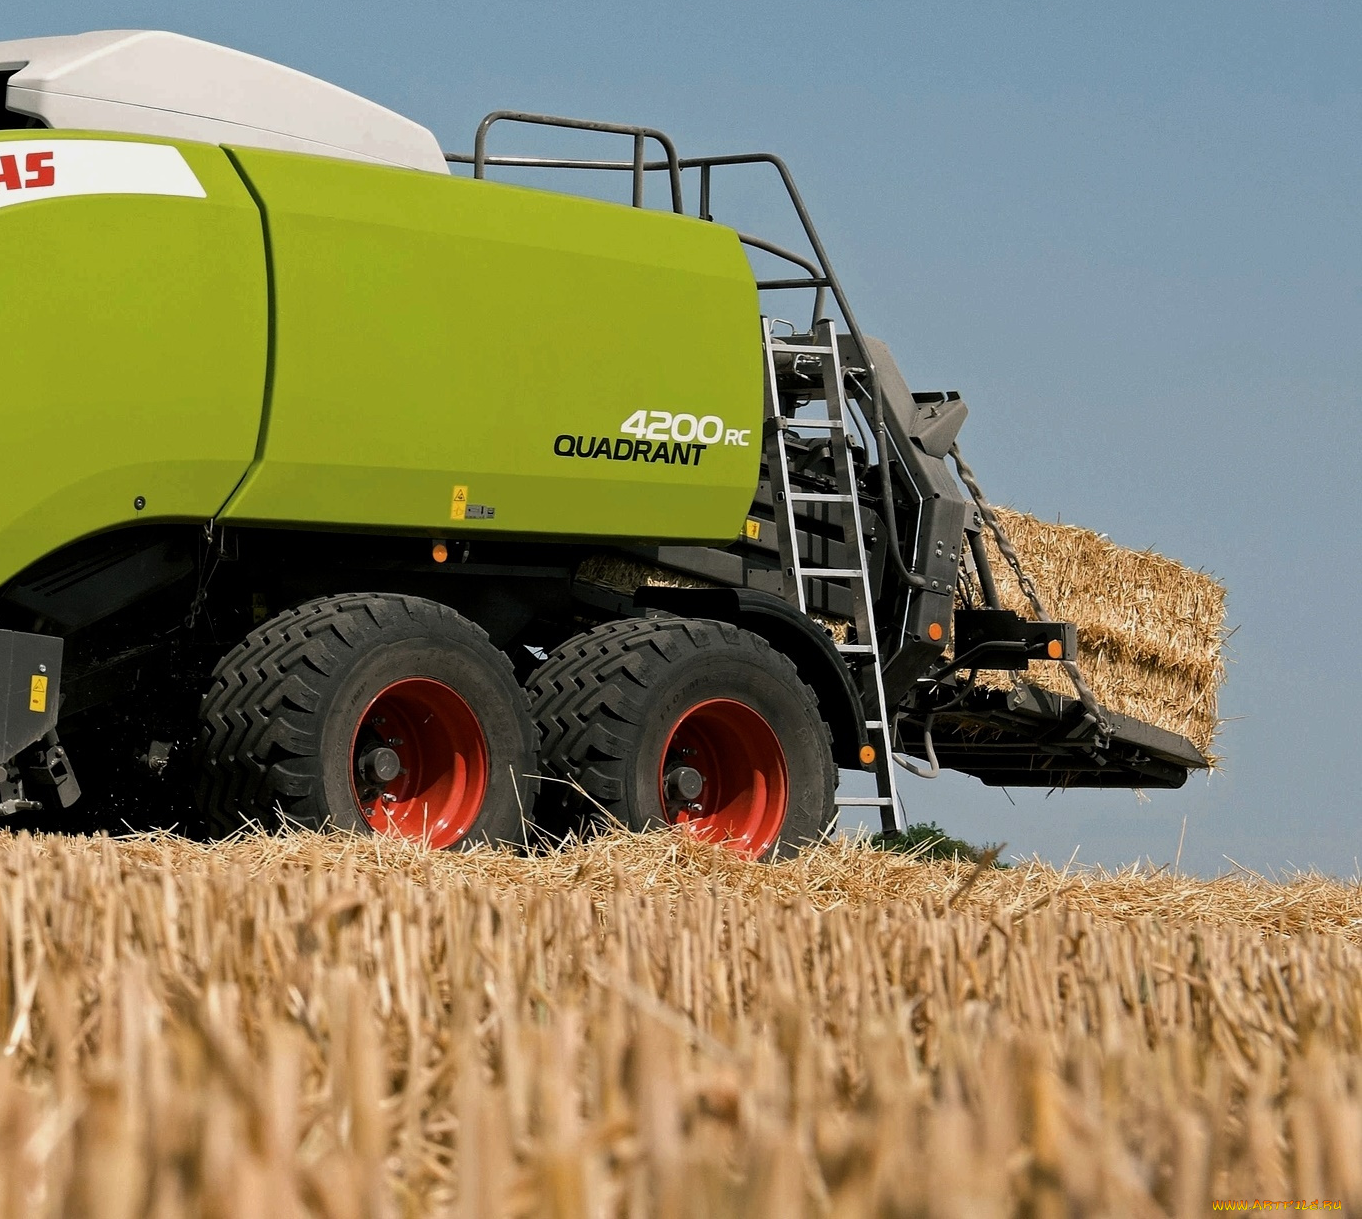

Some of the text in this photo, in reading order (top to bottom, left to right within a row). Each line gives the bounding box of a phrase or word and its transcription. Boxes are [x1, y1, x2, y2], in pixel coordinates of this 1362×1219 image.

[620, 409, 751, 447] 4200 RC
[554, 434, 707, 466] QUADRANT
